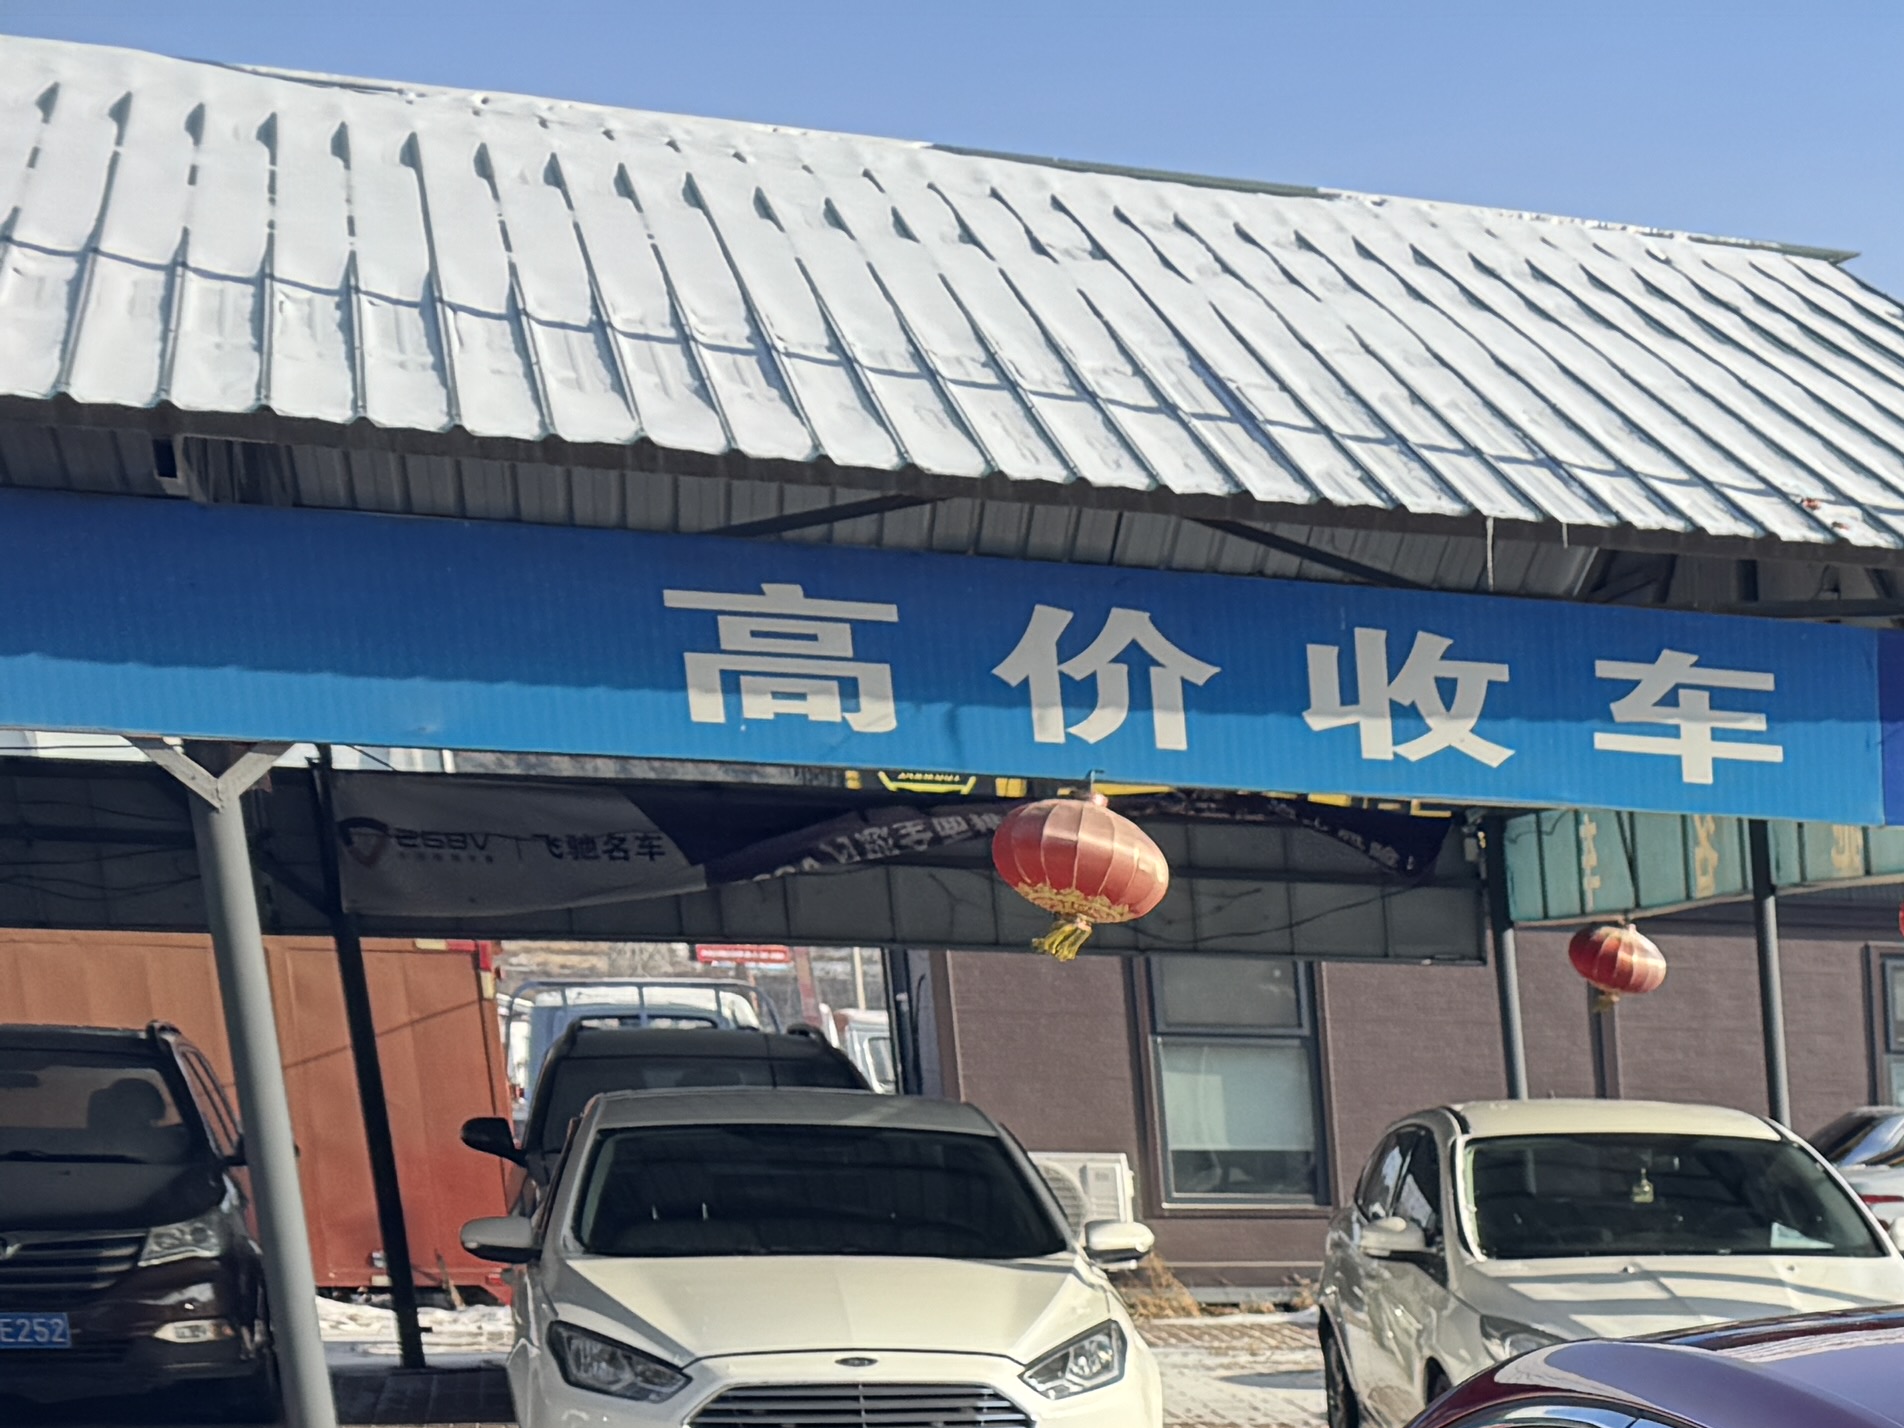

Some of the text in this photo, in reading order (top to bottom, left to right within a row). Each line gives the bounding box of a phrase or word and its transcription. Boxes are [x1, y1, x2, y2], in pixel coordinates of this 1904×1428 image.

[663, 583, 1784, 784] 高价收车
[533, 833, 667, 862] 飞驰名车
